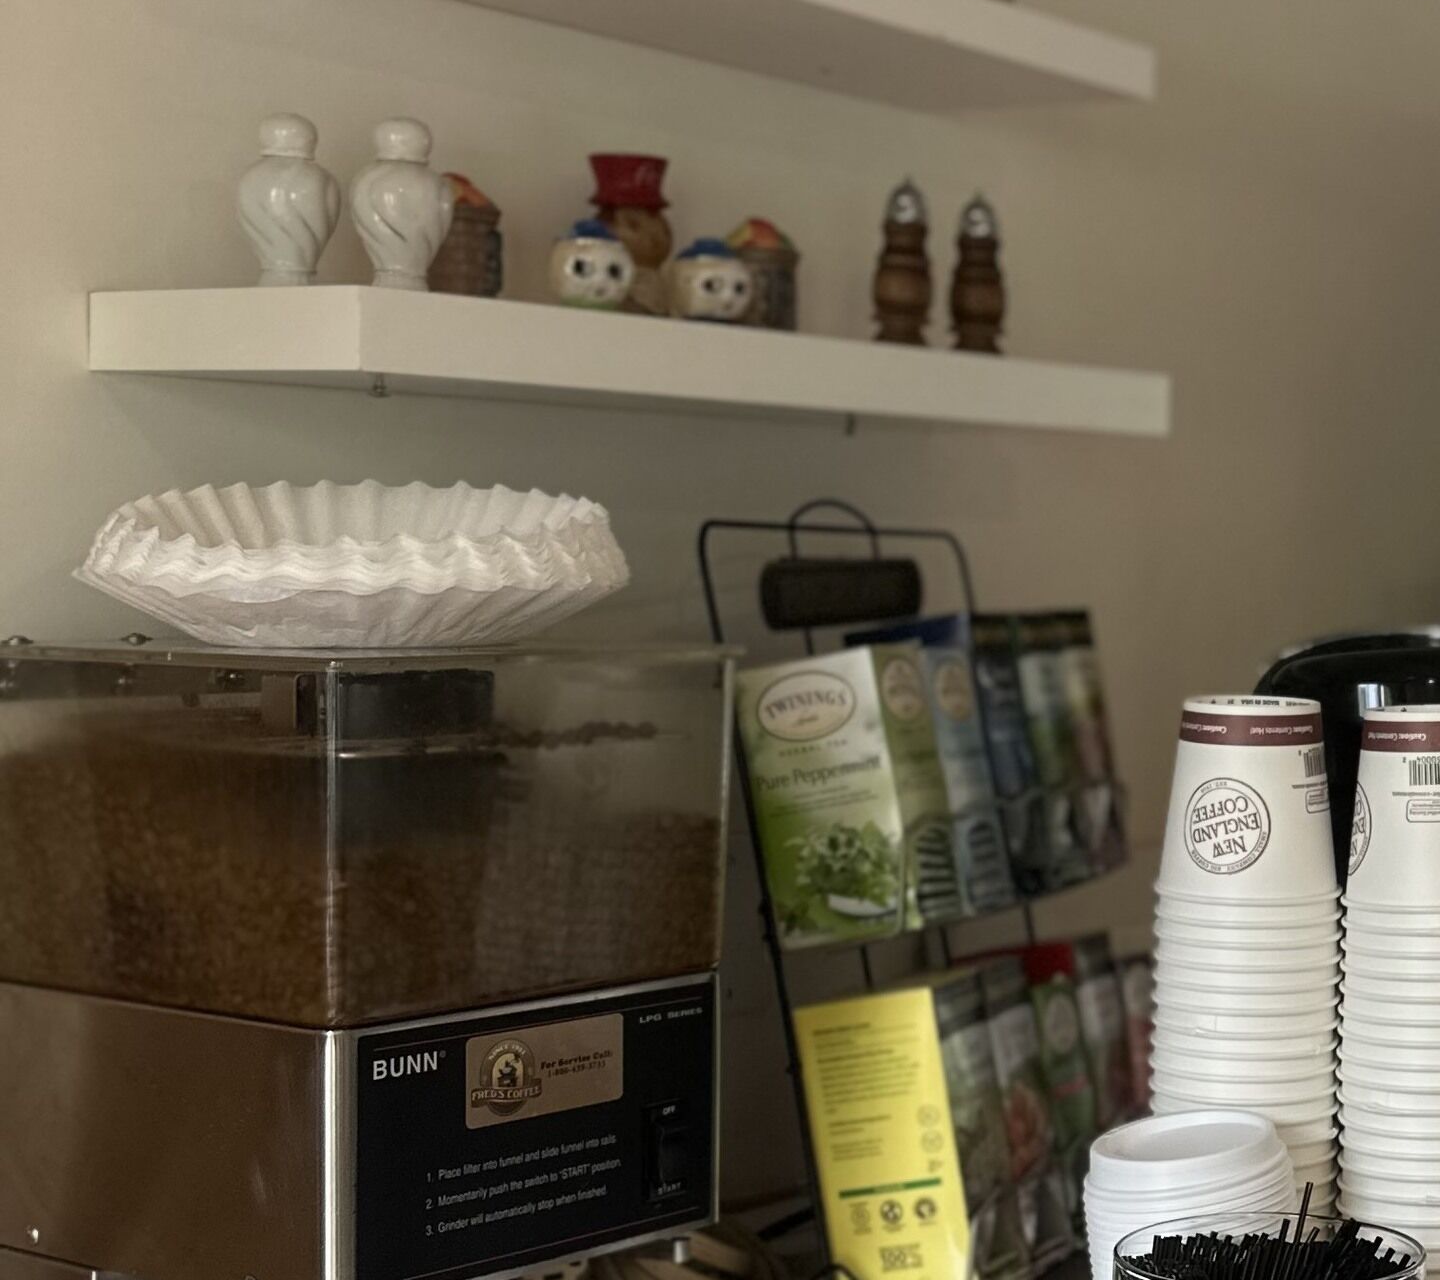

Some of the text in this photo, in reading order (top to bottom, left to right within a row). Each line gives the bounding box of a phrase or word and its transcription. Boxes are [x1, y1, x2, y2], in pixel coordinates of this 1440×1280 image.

[1399, 732, 1427, 742] Caution:
[1192, 795, 1250, 825] COFFEE
[1192, 811, 1261, 844] ENGLAND
[1211, 834, 1248, 858] NEW
[372, 1050, 438, 1081] BUNN
[438, 1217, 471, 1233] Grinder
